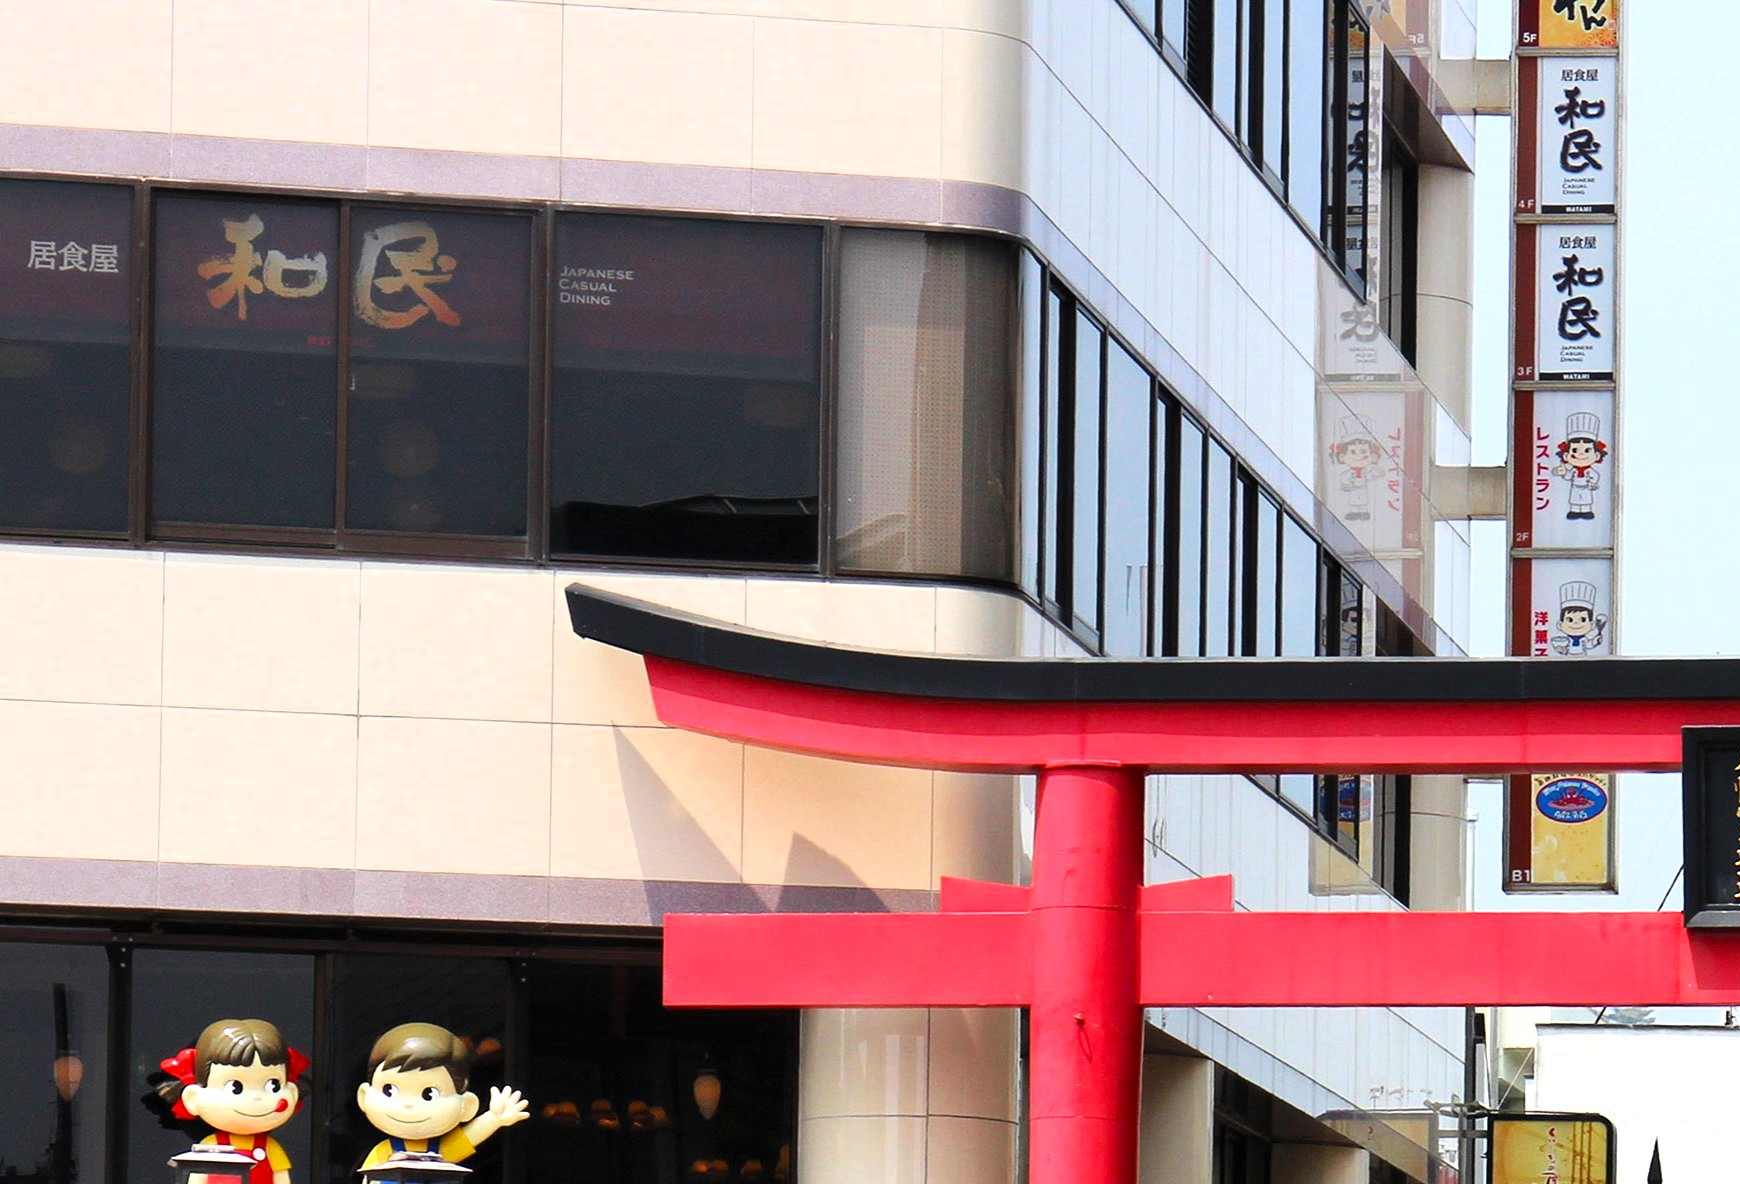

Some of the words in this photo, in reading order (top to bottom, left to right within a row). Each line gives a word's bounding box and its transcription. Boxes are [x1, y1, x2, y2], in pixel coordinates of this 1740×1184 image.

[1523, 33, 1537, 43] 5F
[1561, 69, 1599, 81] 居食屋
[1554, 86, 1605, 173] 和民
[1519, 200, 1534, 209] 4F
[1559, 236, 1597, 249] 居食屋
[27, 241, 119, 273] 居食屋
[199, 213, 461, 329] 和民
[560, 265, 635, 281] JAPANESE
[558, 278, 618, 293] CASUAL
[559, 291, 611, 306] DINING
[1553, 254, 1604, 341] 和民
[1518, 367, 1533, 377] 3F
[1535, 427, 1550, 511] レストラン
[1516, 532, 1530, 542] 2F
[1512, 870, 1531, 883] B1
